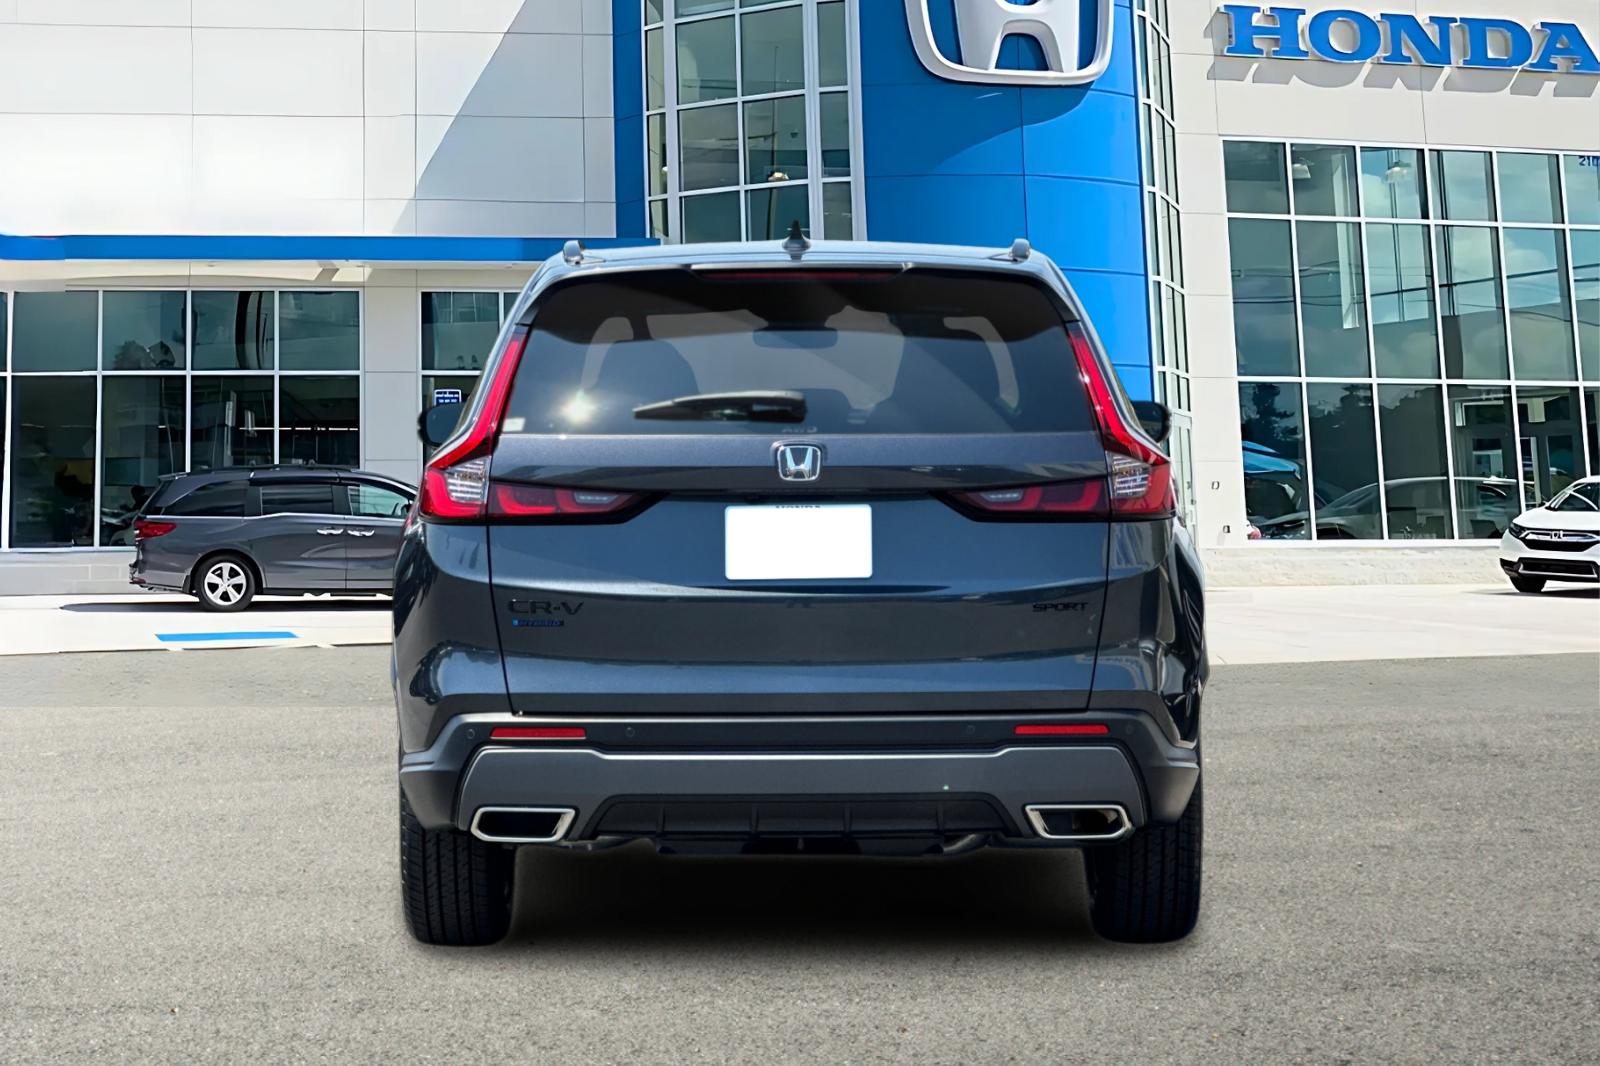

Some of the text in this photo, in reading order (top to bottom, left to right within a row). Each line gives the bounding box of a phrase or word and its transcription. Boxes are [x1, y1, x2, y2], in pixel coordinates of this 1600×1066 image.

[1223, 4, 1600, 73] HONDA
[508, 599, 584, 615] CR-V
[1032, 601, 1089, 612] SPORT
